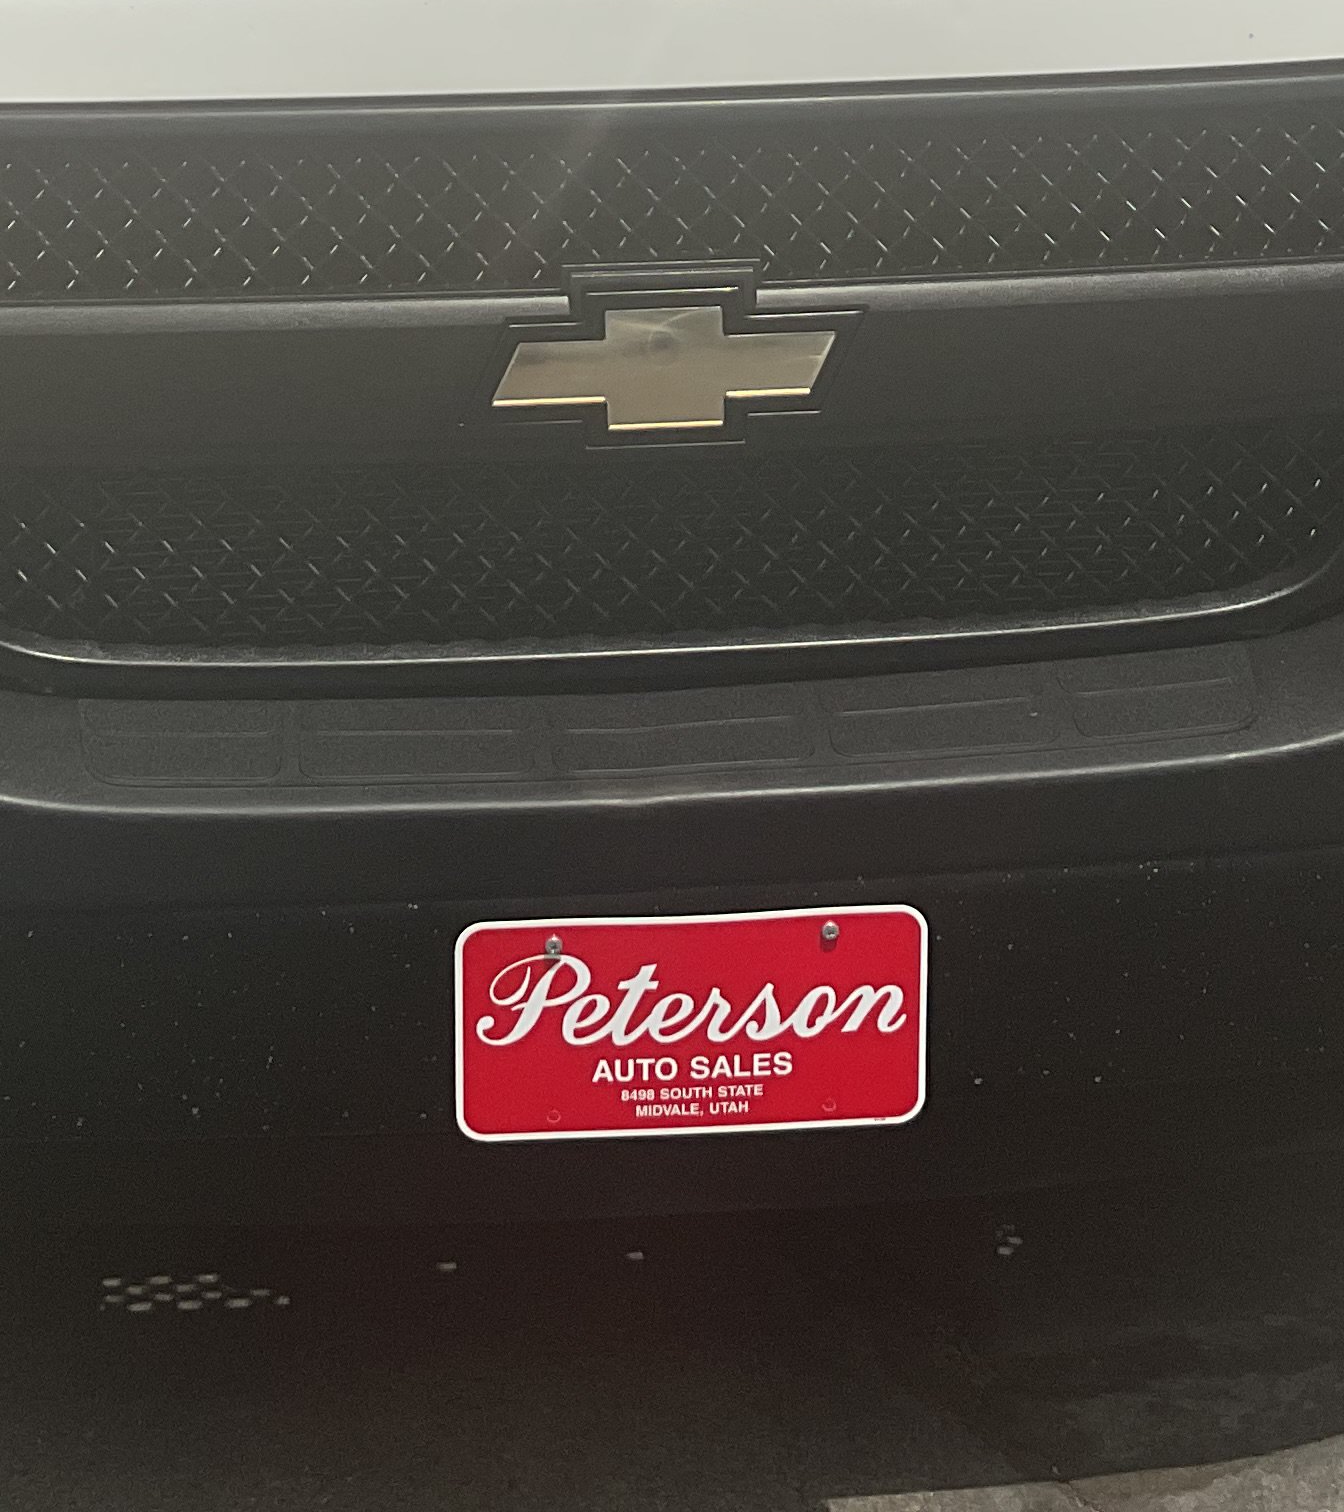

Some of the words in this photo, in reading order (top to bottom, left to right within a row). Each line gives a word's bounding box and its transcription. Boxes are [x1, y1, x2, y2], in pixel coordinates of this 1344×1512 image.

[475, 953, 908, 1047] Peterson
[591, 1057, 679, 1084] AUTO
[690, 1051, 794, 1080] SALES
[620, 1088, 656, 1102] 8498
[659, 1086, 713, 1100] SOUTH
[718, 1083, 764, 1097] STATE
[635, 1102, 704, 1117] MIDVALE,
[709, 1100, 749, 1115] UTAH
